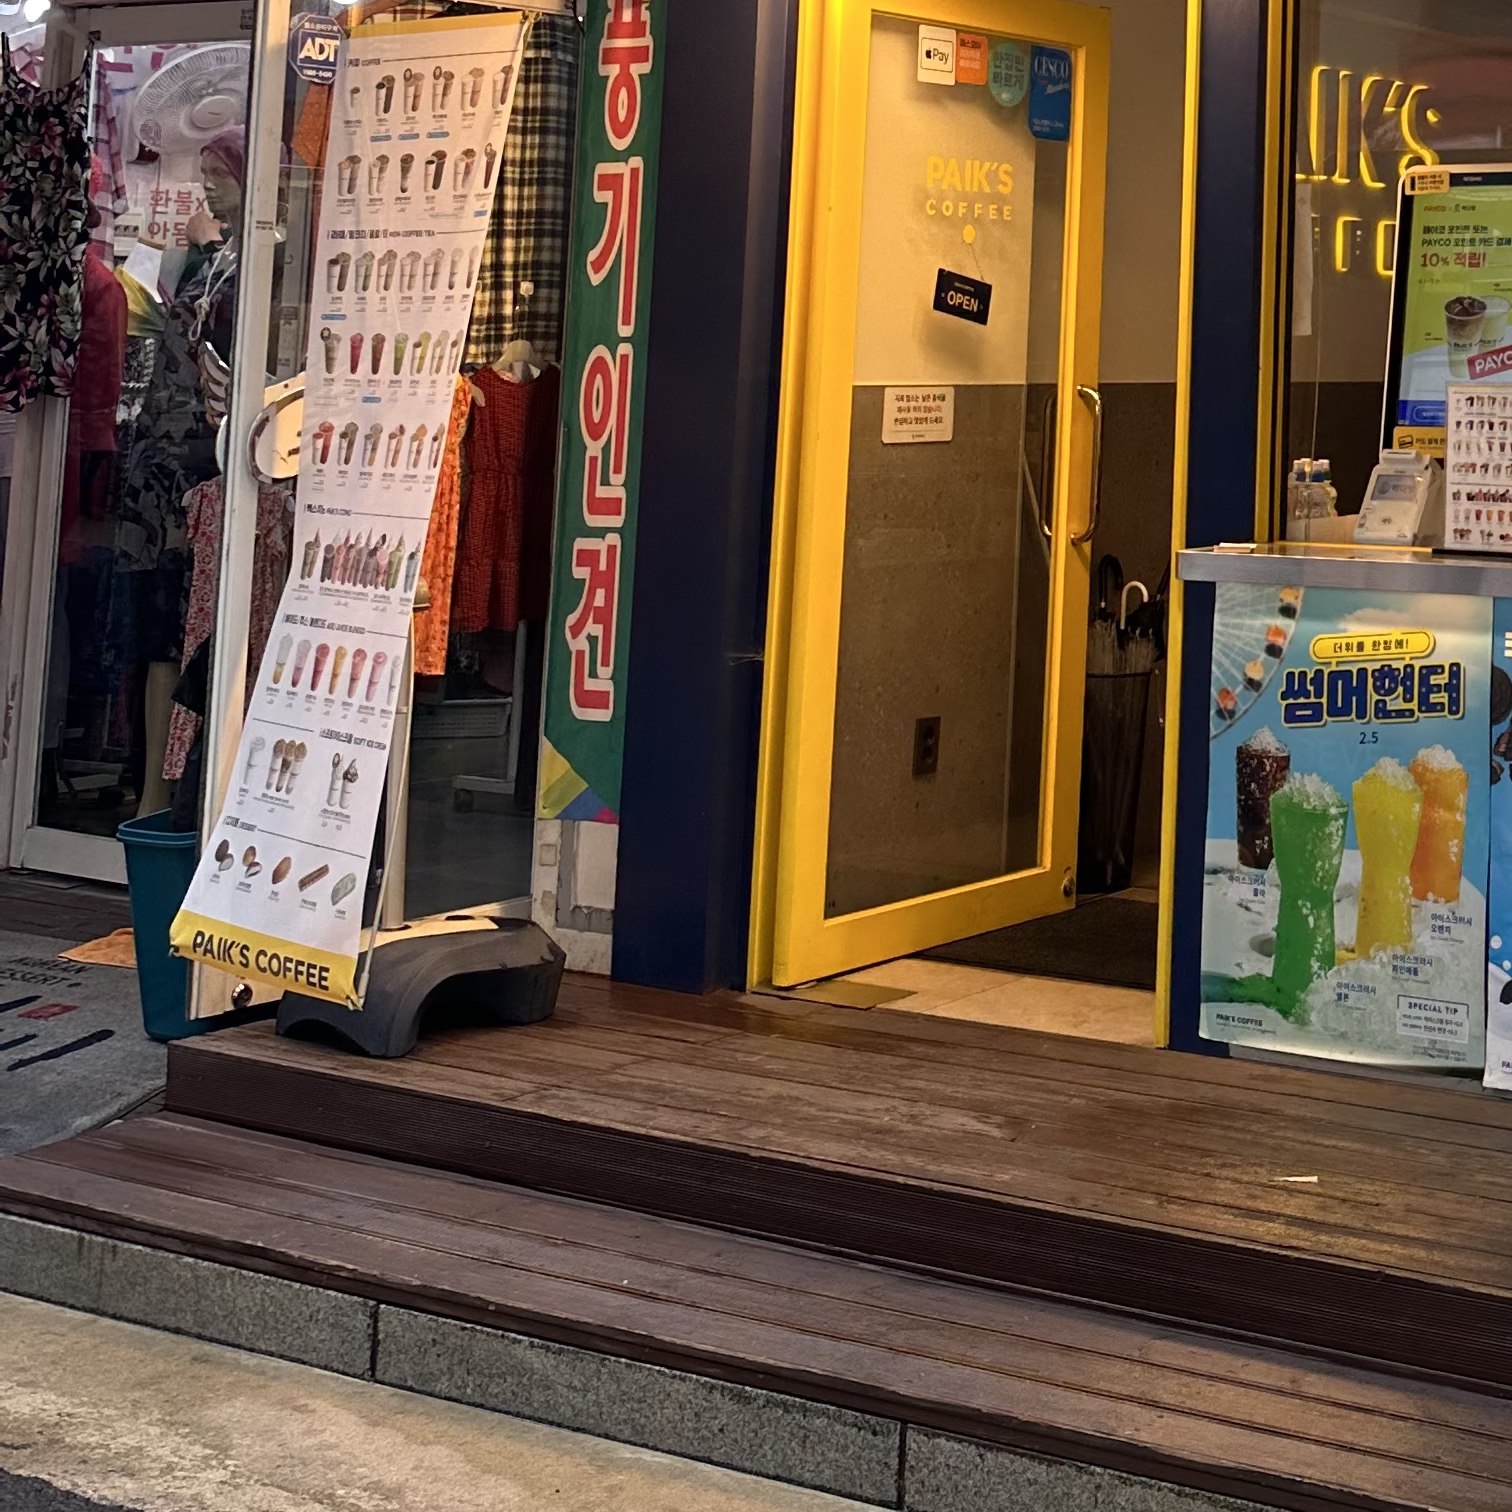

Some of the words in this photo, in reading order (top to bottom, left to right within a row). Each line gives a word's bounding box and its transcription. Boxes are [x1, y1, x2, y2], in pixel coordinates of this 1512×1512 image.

[298, 37, 340, 62] ADT
[932, 48, 949, 65] Pay
[1034, 55, 1069, 80] CESCO
[926, 155, 1013, 195] PAIK'S
[926, 199, 1012, 220] COFFEE
[1422, 238, 1451, 247] PAYCO
[1453, 238, 1476, 247] 포인트
[1478, 238, 1494, 246] 카드
[1420, 253, 1449, 268] 10%
[947, 290, 979, 313] OPEN
[1280, 662, 1462, 725] 썸머헌터
[1359, 731, 1379, 745] 2.5
[192, 929, 249, 970] PAIK'S
[255, 949, 330, 991] COFFEE
[1408, 1001, 1442, 1014] SPECIAL
[1446, 1006, 1458, 1016] TIP
[1237, 1017, 1263, 1027] COFFEE
